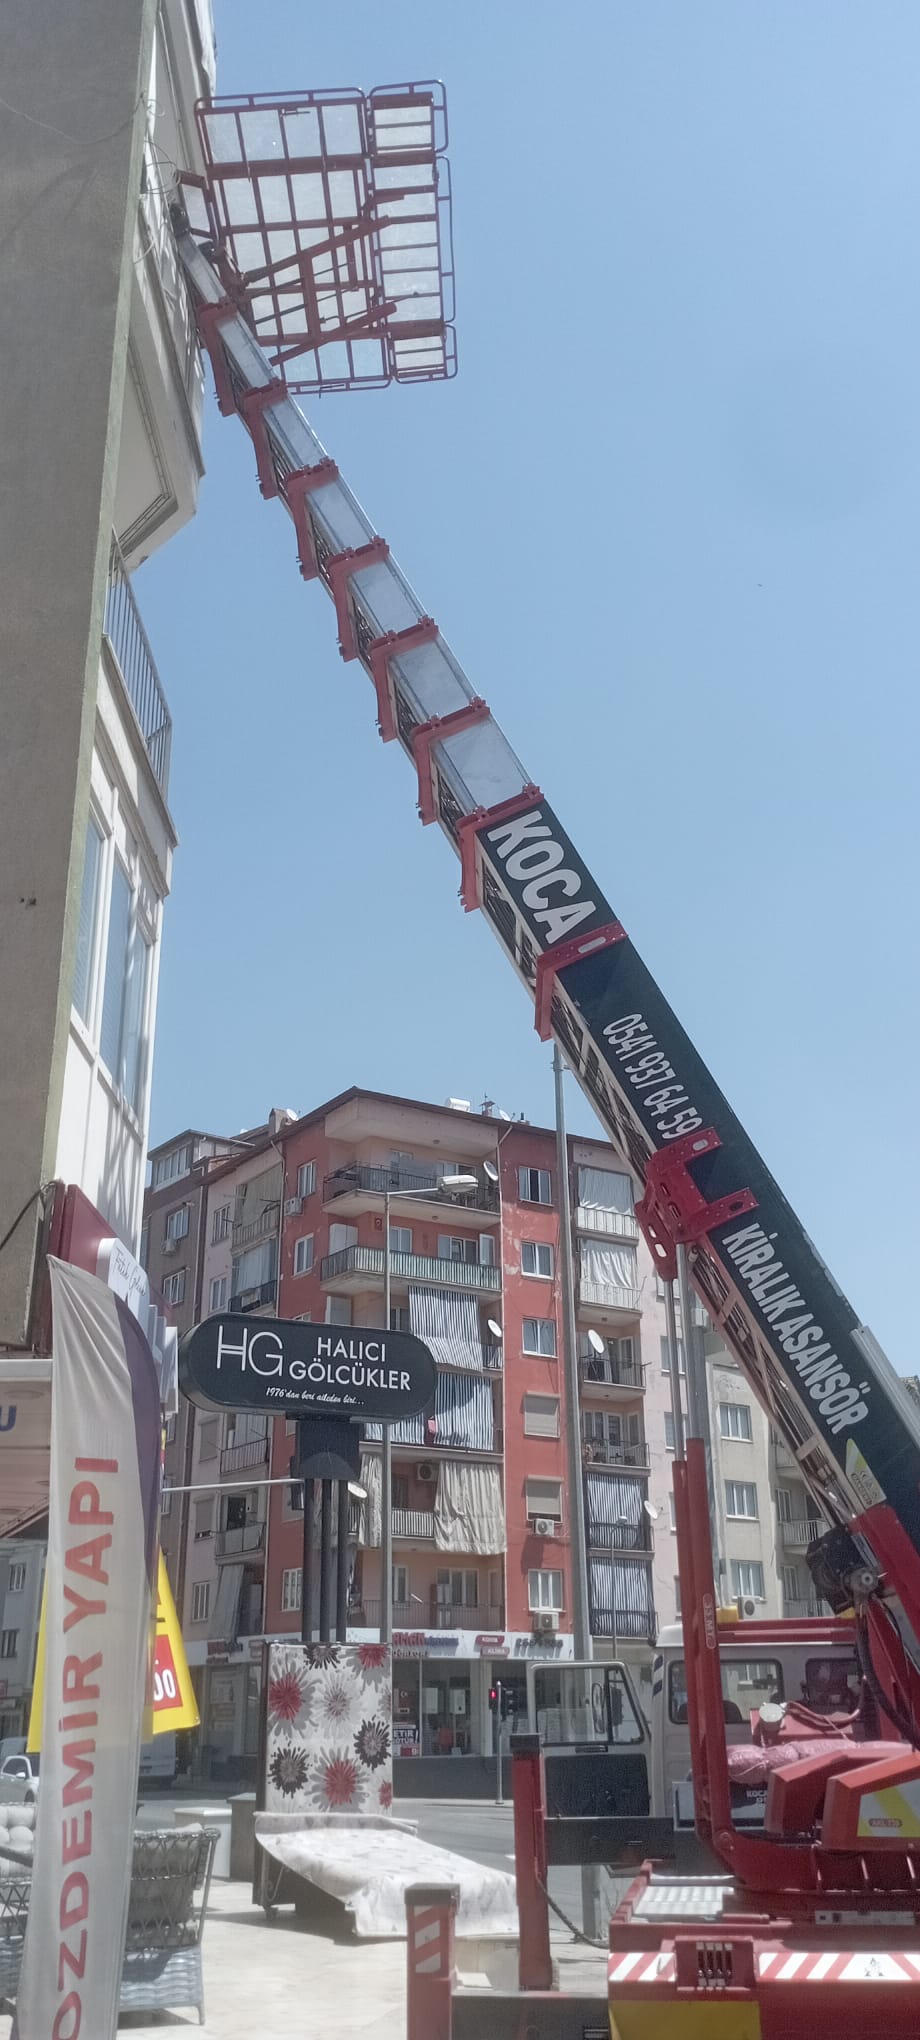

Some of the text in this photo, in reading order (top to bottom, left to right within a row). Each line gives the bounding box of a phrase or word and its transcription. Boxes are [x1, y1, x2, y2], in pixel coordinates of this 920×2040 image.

[487, 810, 596, 944] KOCA
[603, 1013, 703, 1139] 0541 937 64 59
[216, 1325, 283, 1377] HG
[289, 1358, 411, 1391] GÖLCÜKLER
[317, 1336, 386, 1362] HALICI
[722, 1222, 871, 1435] KİRALIK ASANSÖR
[62, 1457, 119, 1634] YAPI
